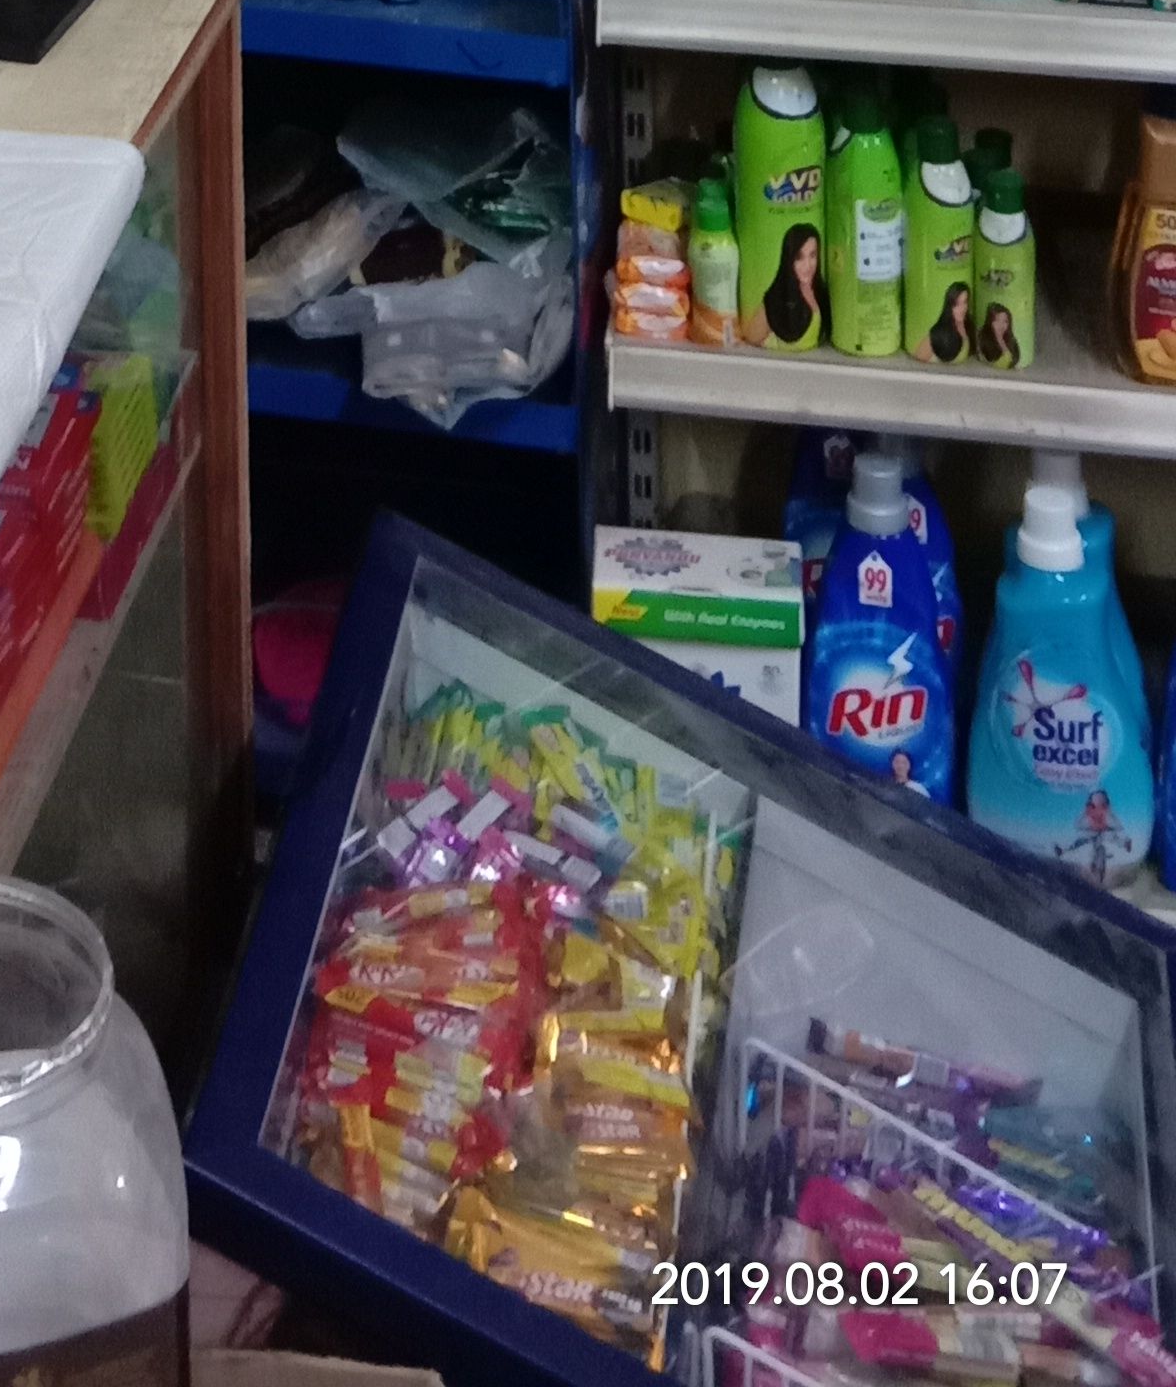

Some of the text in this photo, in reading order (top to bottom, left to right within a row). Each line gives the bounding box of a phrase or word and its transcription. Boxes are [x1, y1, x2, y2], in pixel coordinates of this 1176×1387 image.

[864, 567, 888, 594] 99
[827, 687, 927, 738] Rin
[1033, 706, 1104, 745] Surf
[1032, 744, 1100, 767] excel
